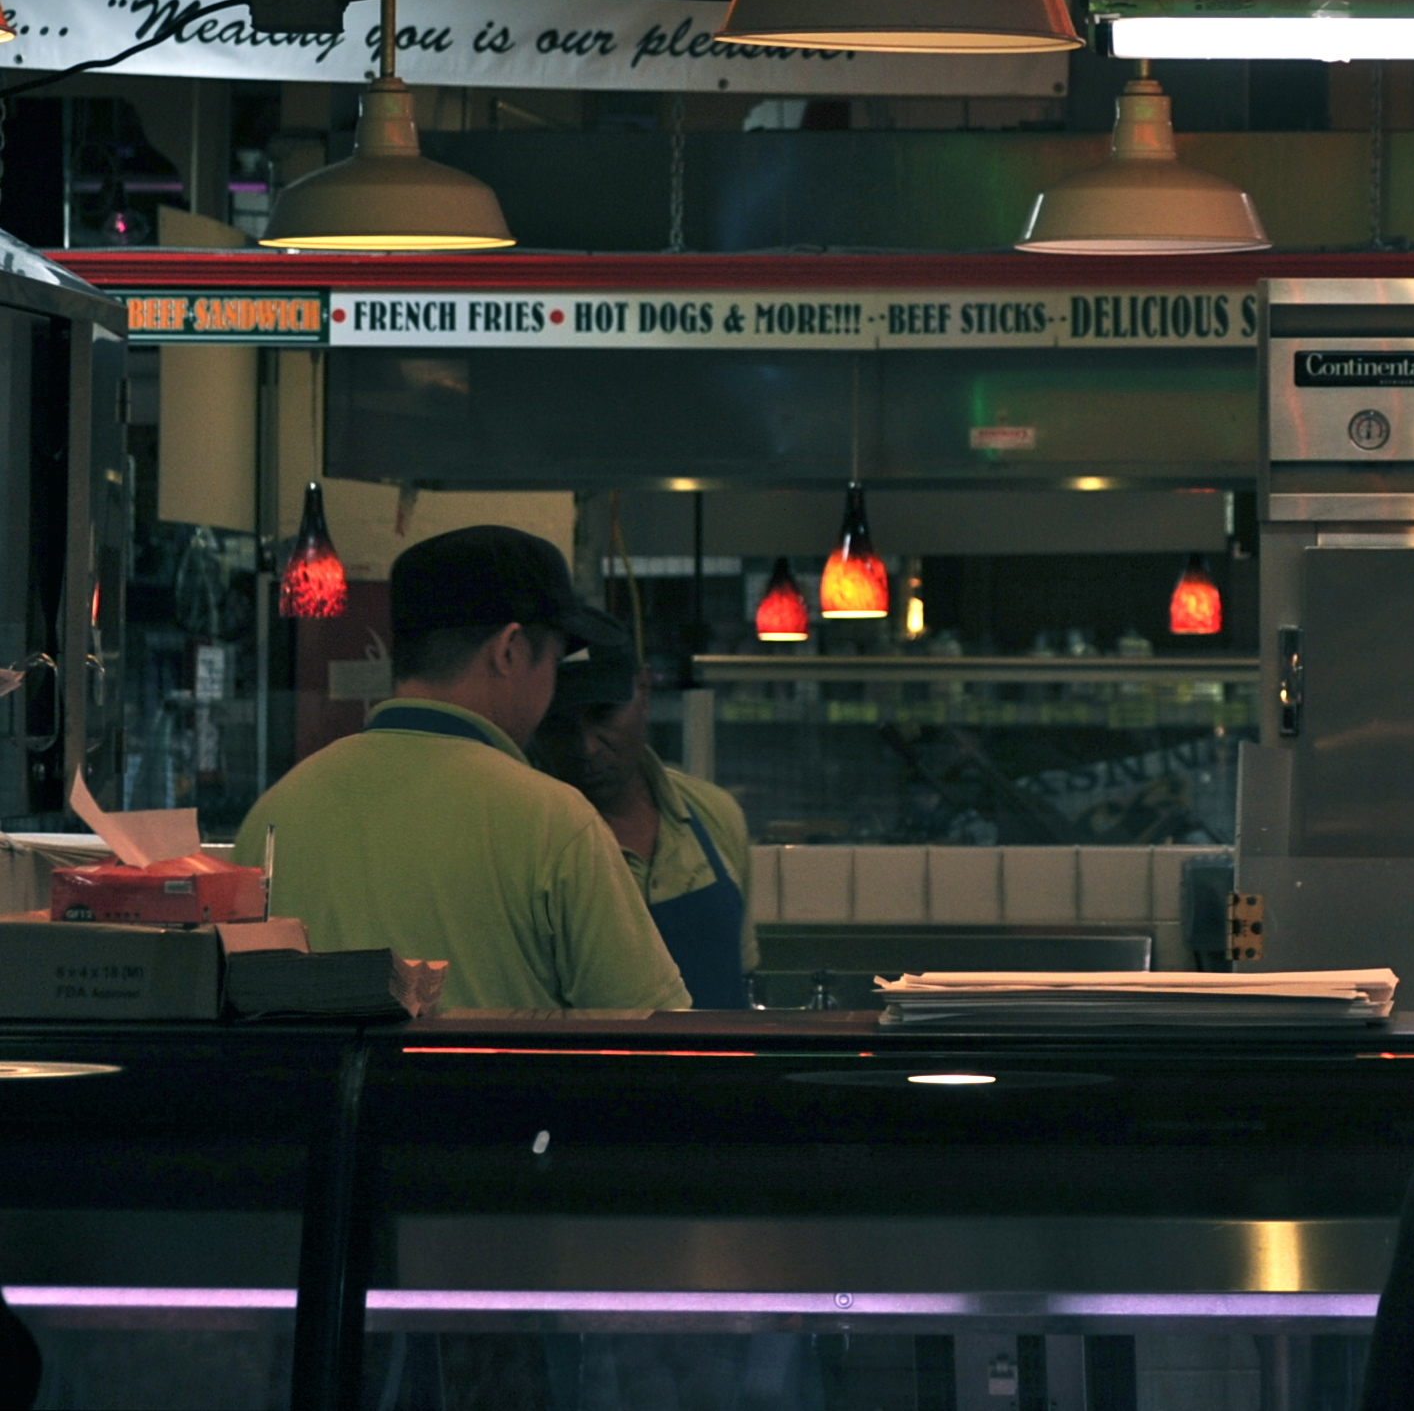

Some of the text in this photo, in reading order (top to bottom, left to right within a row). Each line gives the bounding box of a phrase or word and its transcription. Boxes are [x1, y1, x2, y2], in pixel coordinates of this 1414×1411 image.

[365, 24, 453, 62] you
[472, 20, 515, 54] is
[535, 29, 618, 56] our
[126, 297, 321, 332] BEEF SANDWICH
[353, 300, 862, 335] FRENCH FRIES HOT DOGS & MORE!!!
[887, 301, 1047, 335] BEEF STICKS
[1069, 294, 1229, 339] DELICIOUS
[55, 984, 88, 998] FDA
